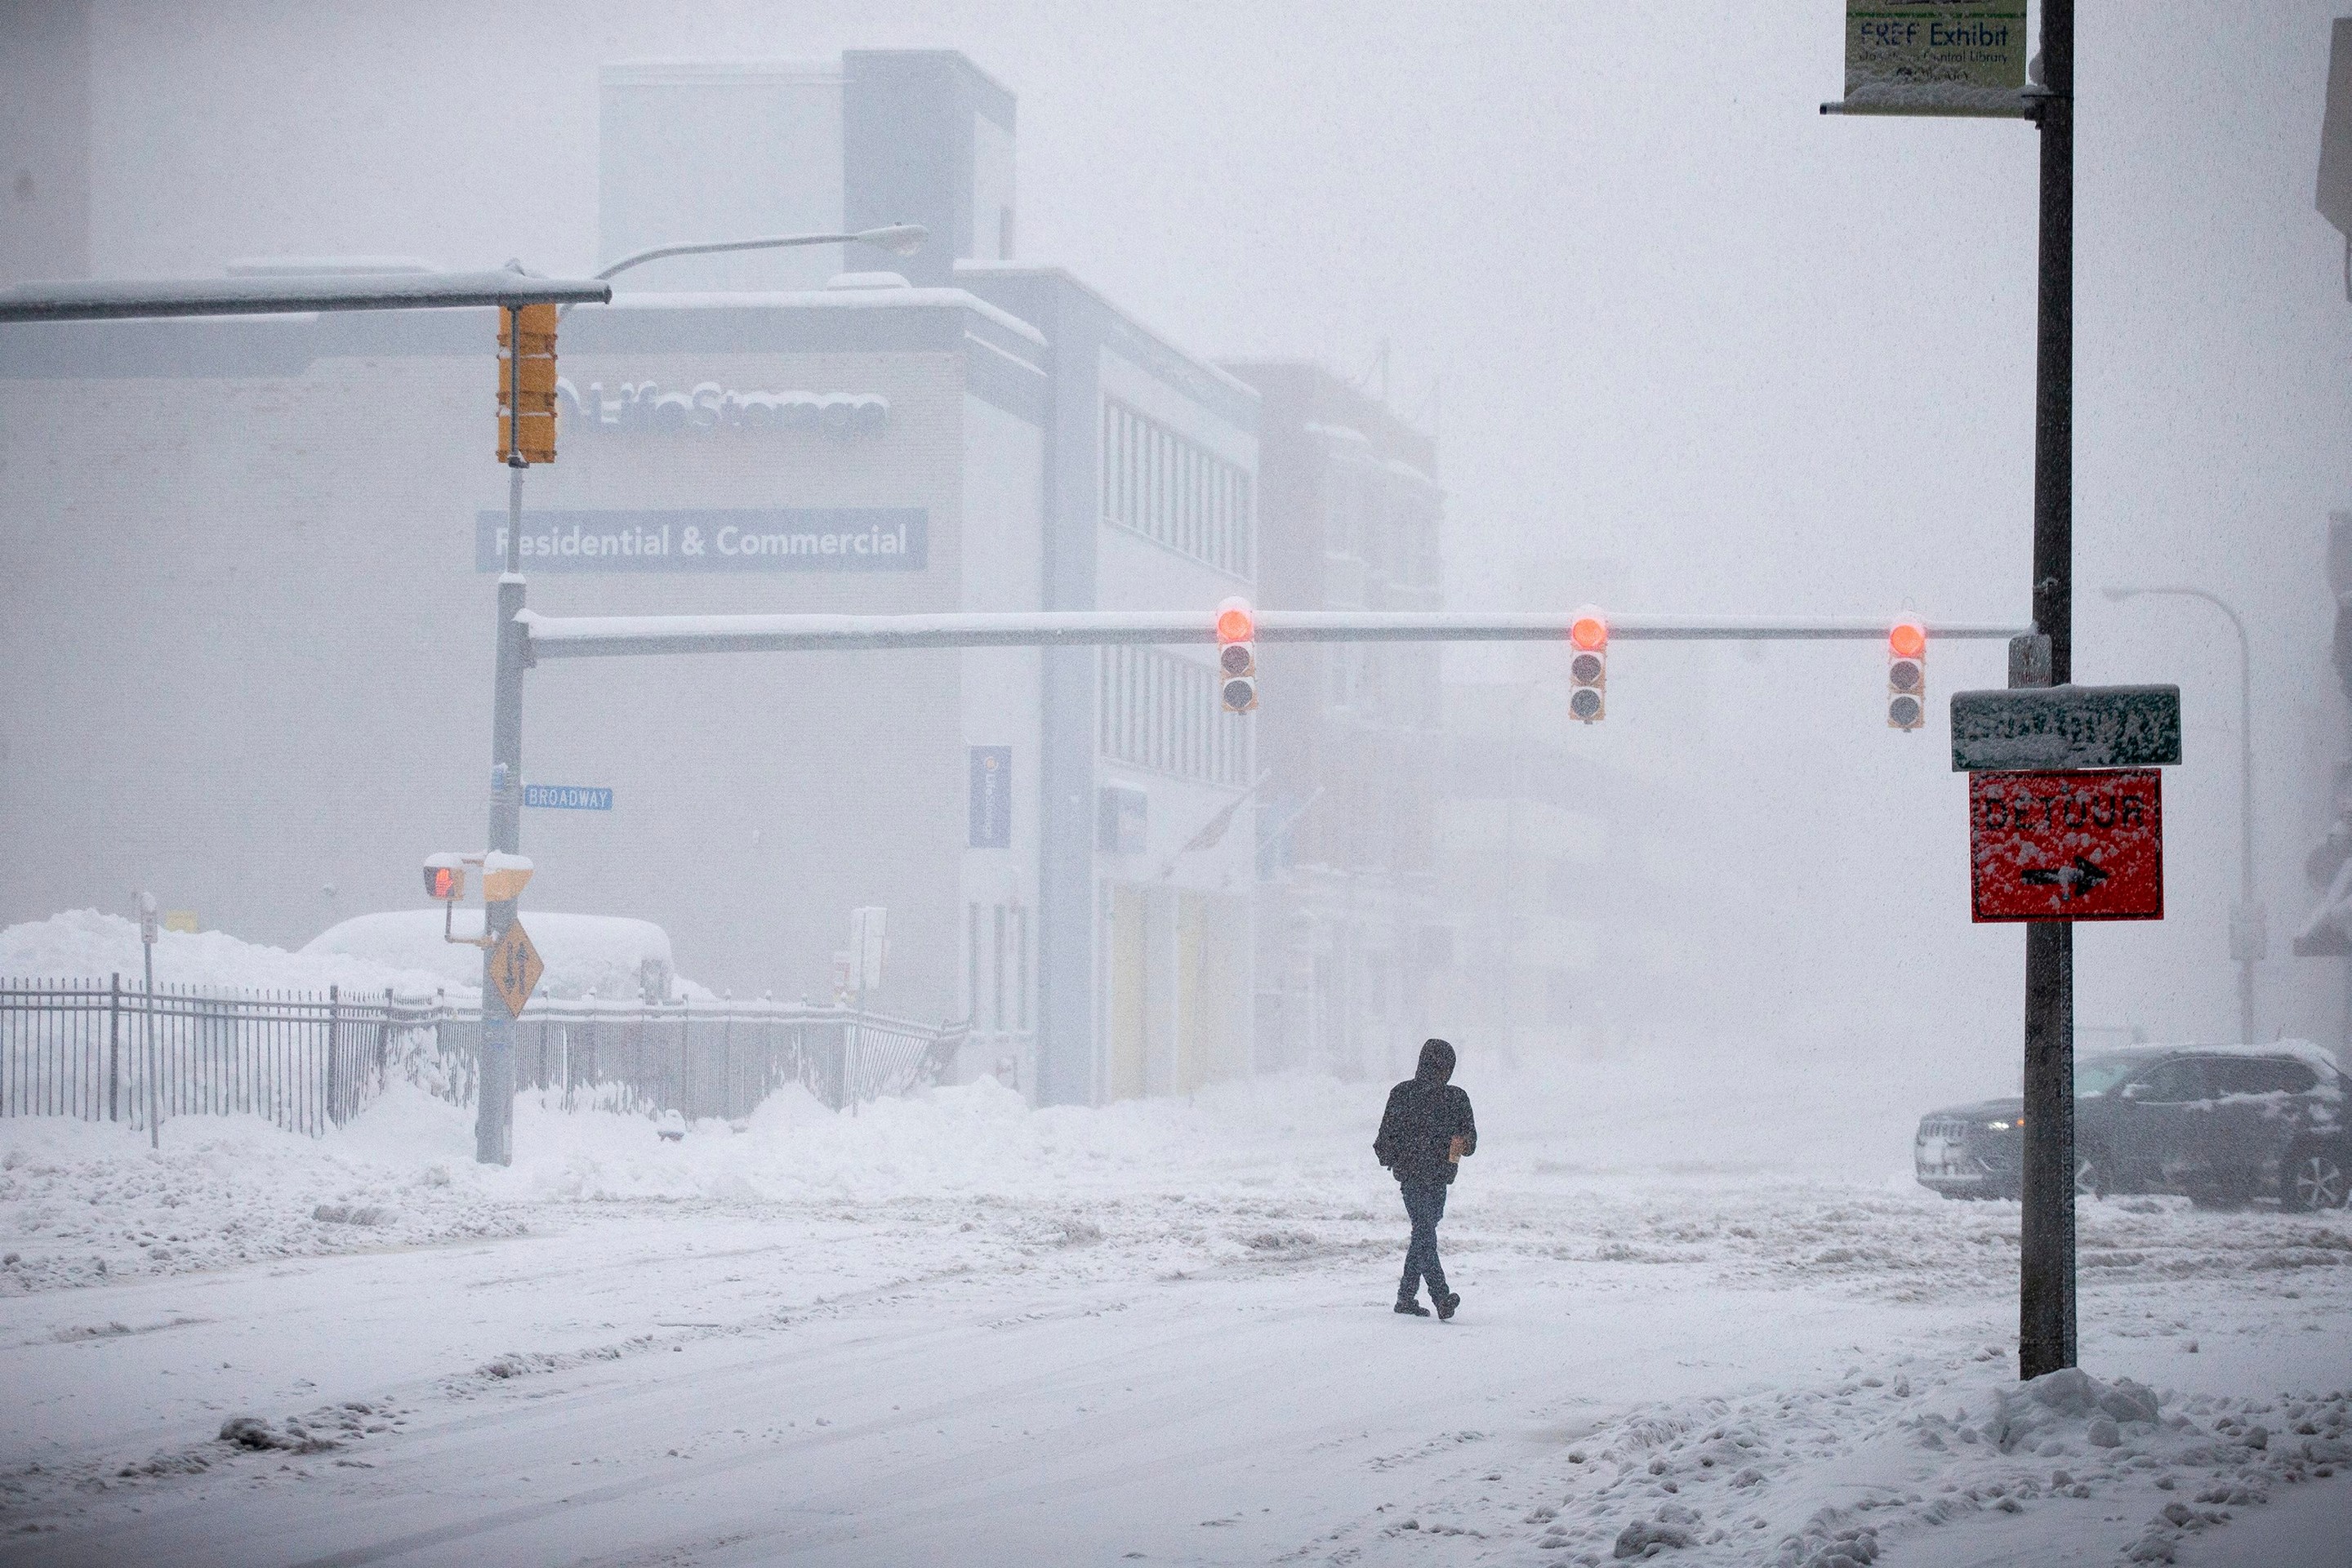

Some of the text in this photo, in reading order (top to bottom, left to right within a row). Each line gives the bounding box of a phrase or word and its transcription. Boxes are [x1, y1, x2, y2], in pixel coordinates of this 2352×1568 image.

[1861, 21, 2008, 46] FREE Exhibit
[1970, 50, 2007, 65] Library
[681, 525, 706, 556] &
[716, 524, 906, 556] Commercial
[529, 788, 608, 808] BROADWAY
[1985, 795, 2144, 830] DETOUR
